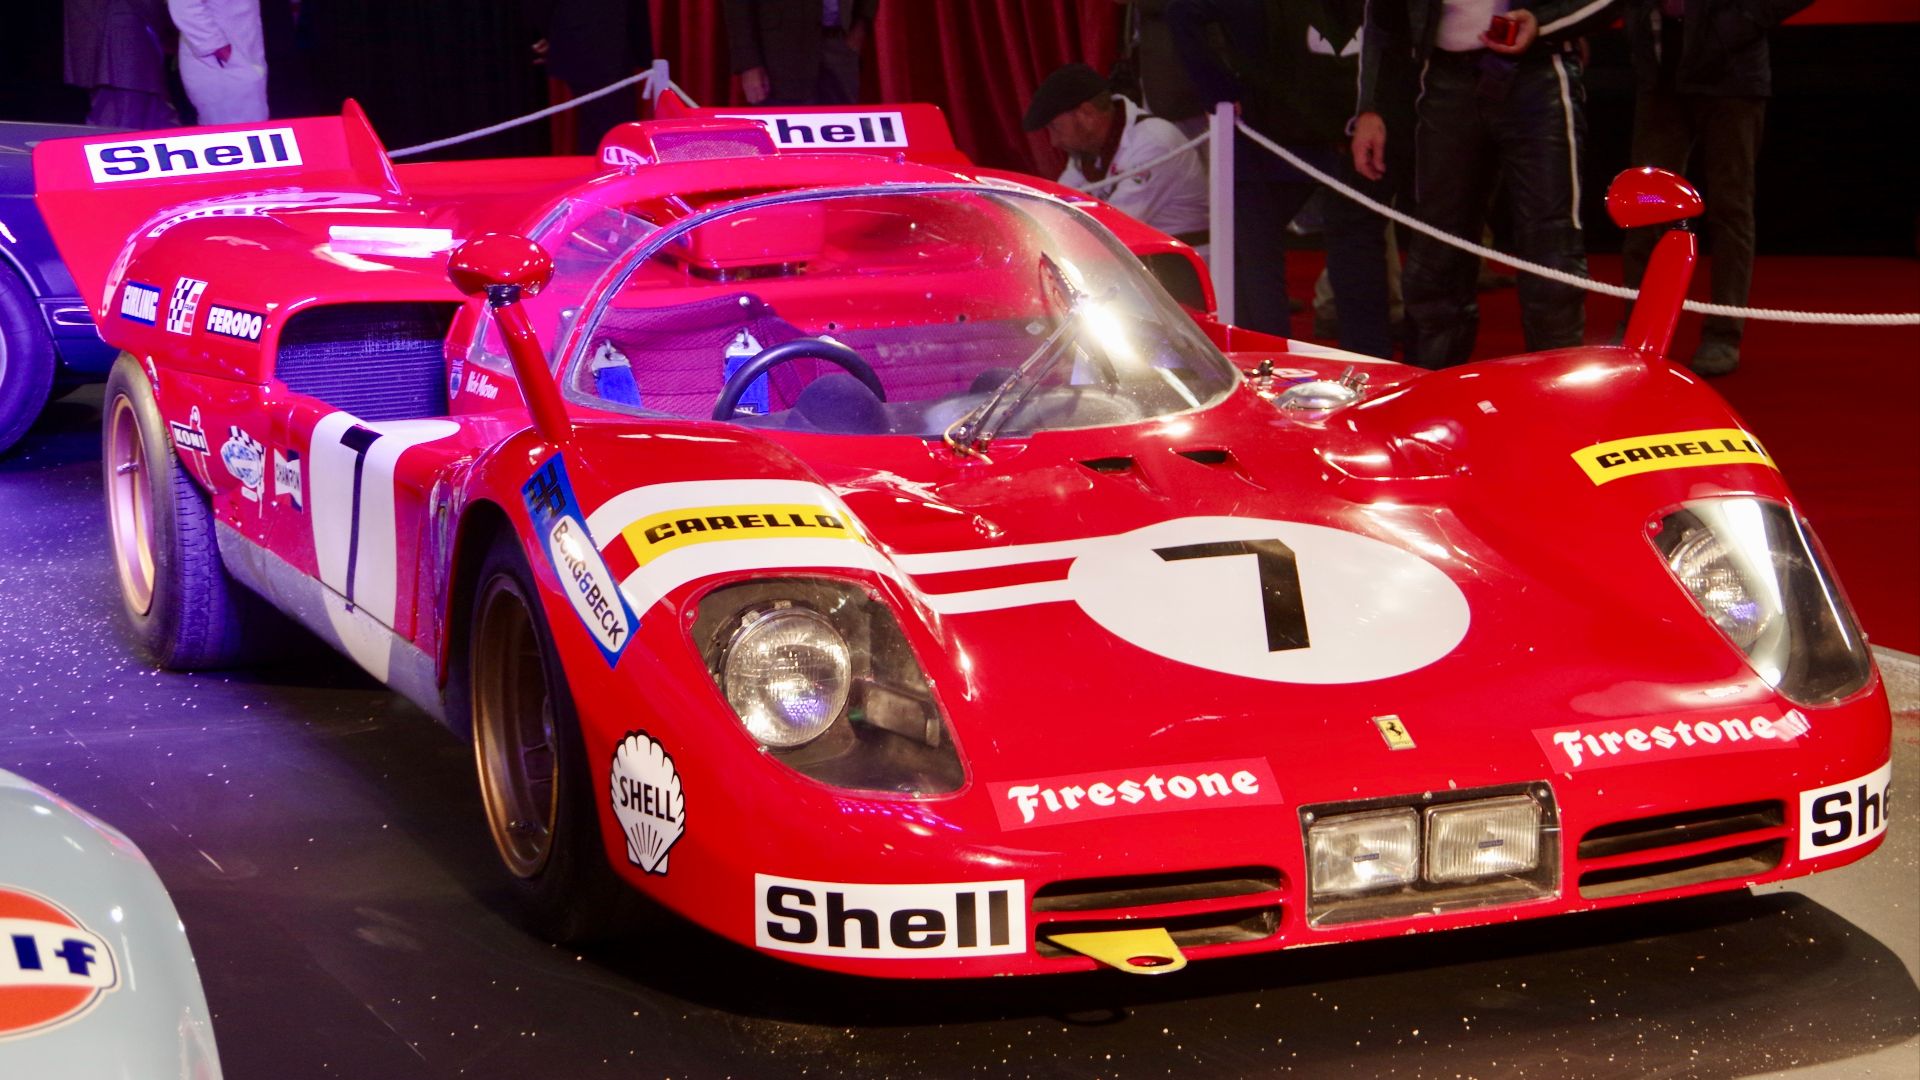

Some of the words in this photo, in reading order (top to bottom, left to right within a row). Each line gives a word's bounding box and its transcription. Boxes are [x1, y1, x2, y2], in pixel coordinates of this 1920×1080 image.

[757, 116, 897, 143] hell
[99, 133, 289, 177] Shell
[206, 306, 262, 340] FERODO
[173, 427, 206, 452] KONI
[340, 423, 384, 614] 7
[644, 513, 845, 545] CARELLO
[1152, 538, 1311, 653] 7
[1553, 715, 1778, 767] Firestone
[619, 775, 677, 824] SHELL
[1007, 770, 1260, 824] Firestone
[766, 884, 1010, 949] Shell
[10, 934, 97, 978] lf
